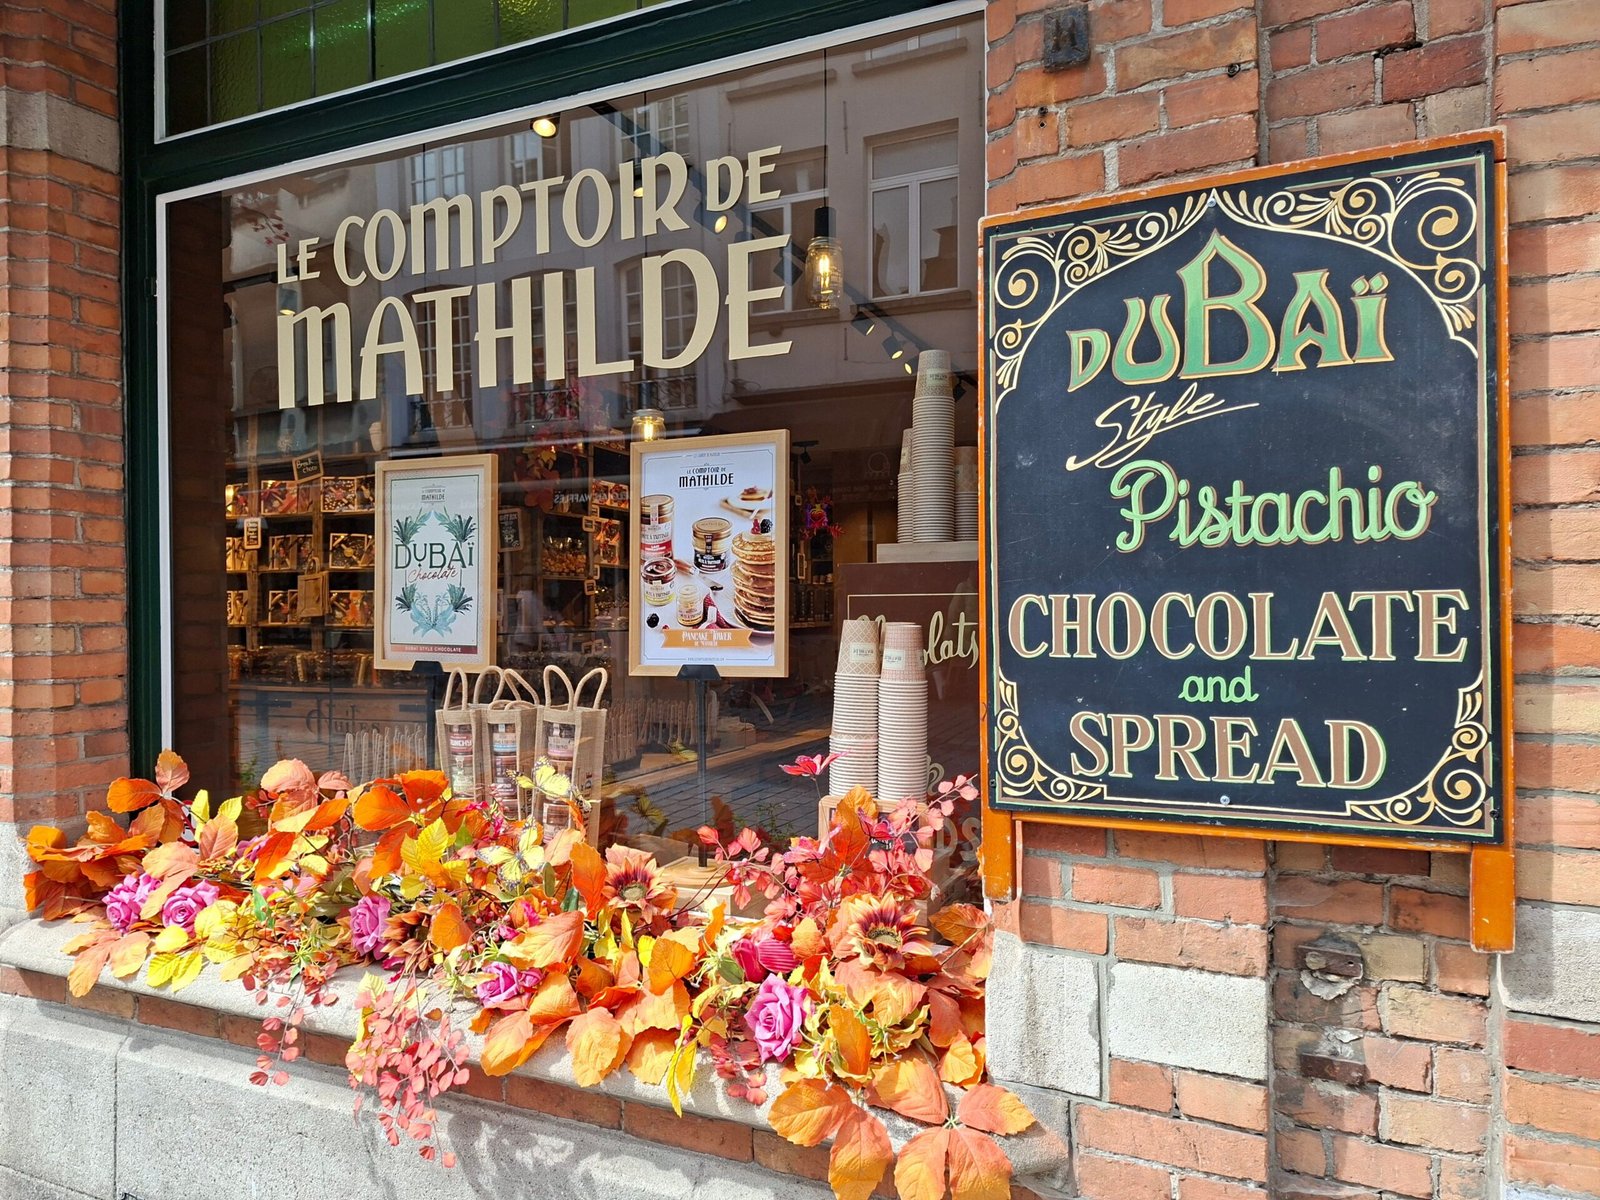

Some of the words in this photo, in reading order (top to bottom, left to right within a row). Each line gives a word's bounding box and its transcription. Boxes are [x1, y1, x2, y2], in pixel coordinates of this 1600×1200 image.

[276, 236, 320, 285] LE
[333, 151, 691, 288] COMPTOIR
[705, 145, 783, 212] DE
[277, 233, 793, 411] MATHILDE
[1066, 228, 1395, 393] DUBAÏ
[1065, 382, 1260, 471] Style
[679, 472, 735, 488] MATHILDE
[692, 466, 720, 475] COMPTOIR
[1110, 459, 1438, 552] Pistachio
[394, 542, 475, 570] DUBAÏ
[407, 565, 459, 584] Chocolate
[1007, 588, 1470, 663] CHOCOLATE
[1178, 665, 1259, 703] and
[1069, 711, 1387, 790] SPREAD
